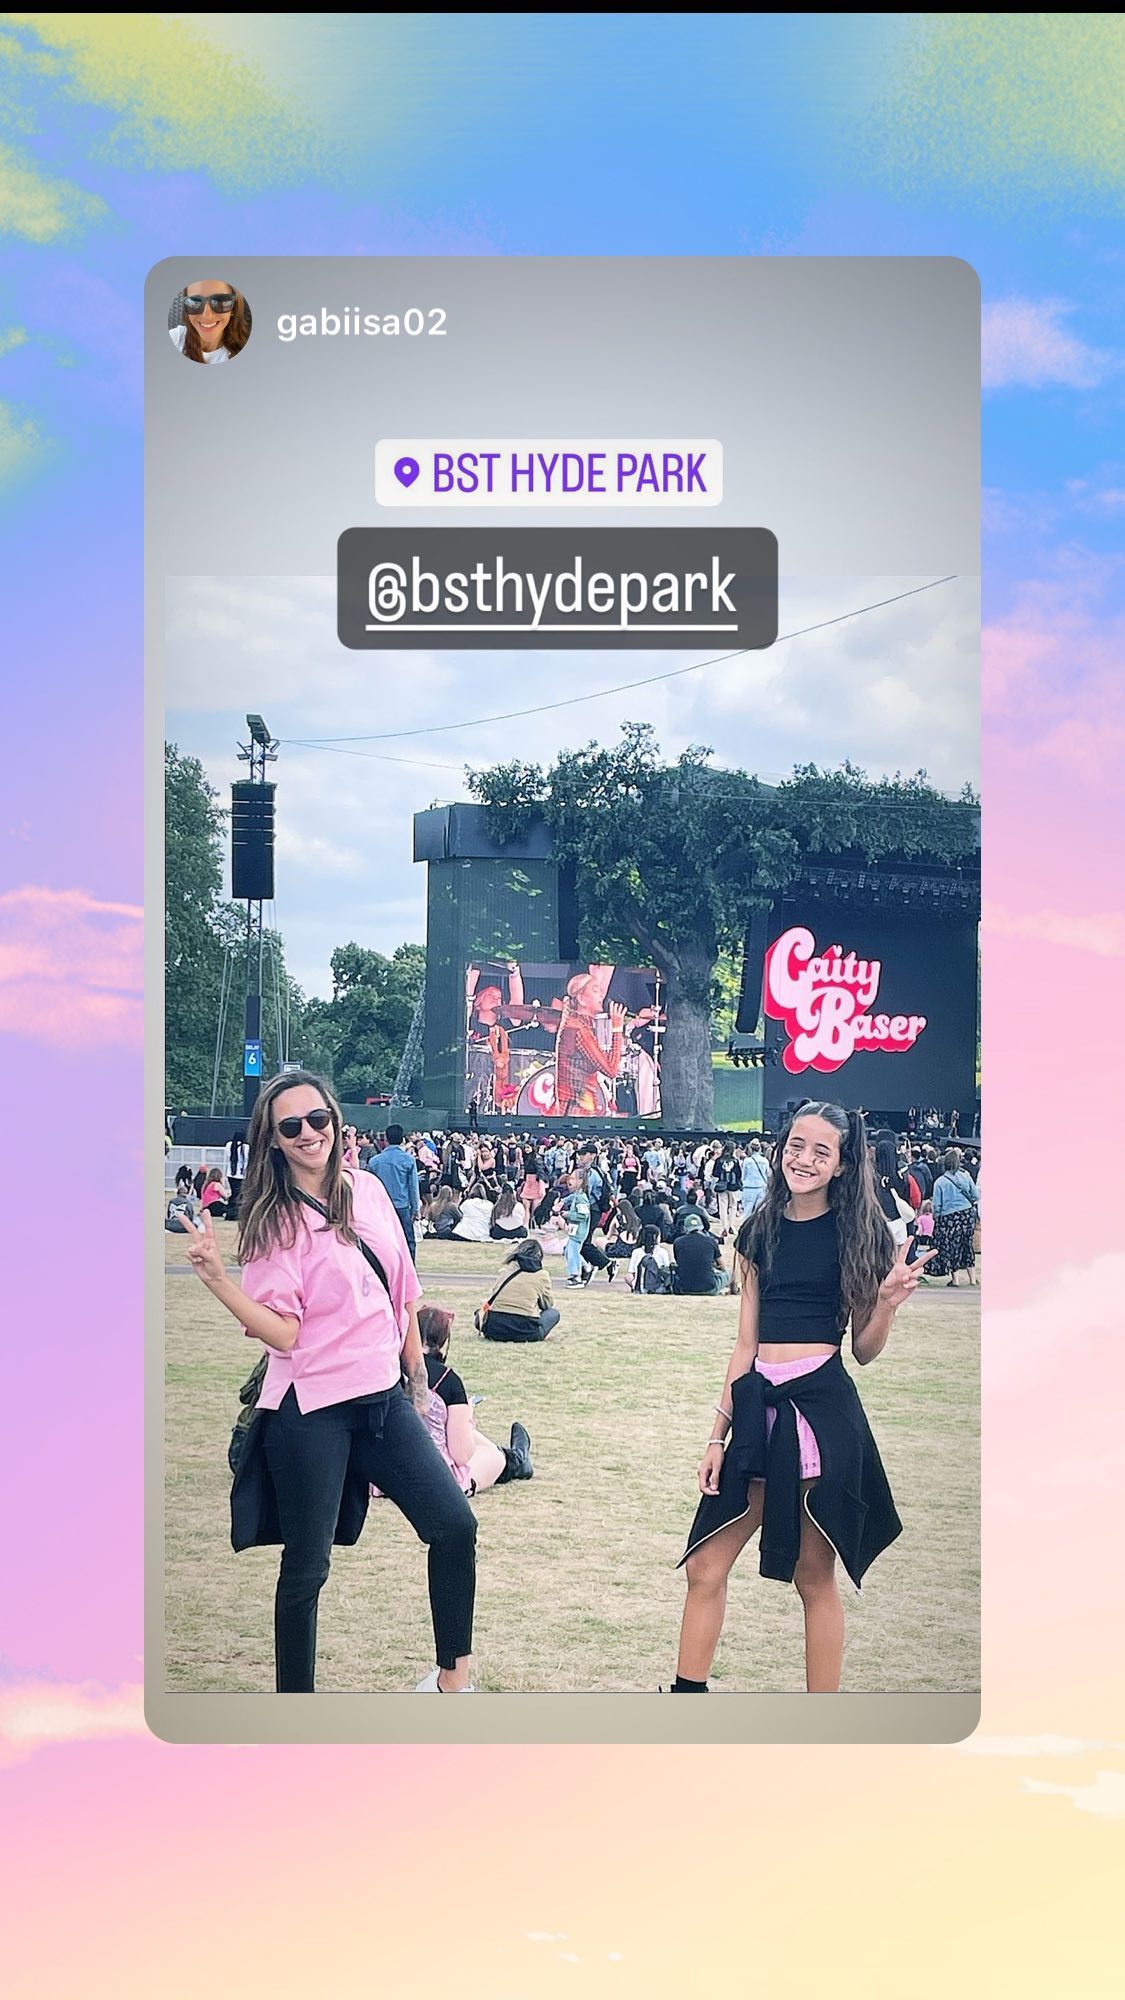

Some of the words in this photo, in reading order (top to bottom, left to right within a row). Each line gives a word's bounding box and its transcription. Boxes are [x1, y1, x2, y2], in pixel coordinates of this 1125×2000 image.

[766, 926, 882, 1009] Caity
[248, 1052, 257, 1065] 6
[792, 986, 928, 1064] Baser
